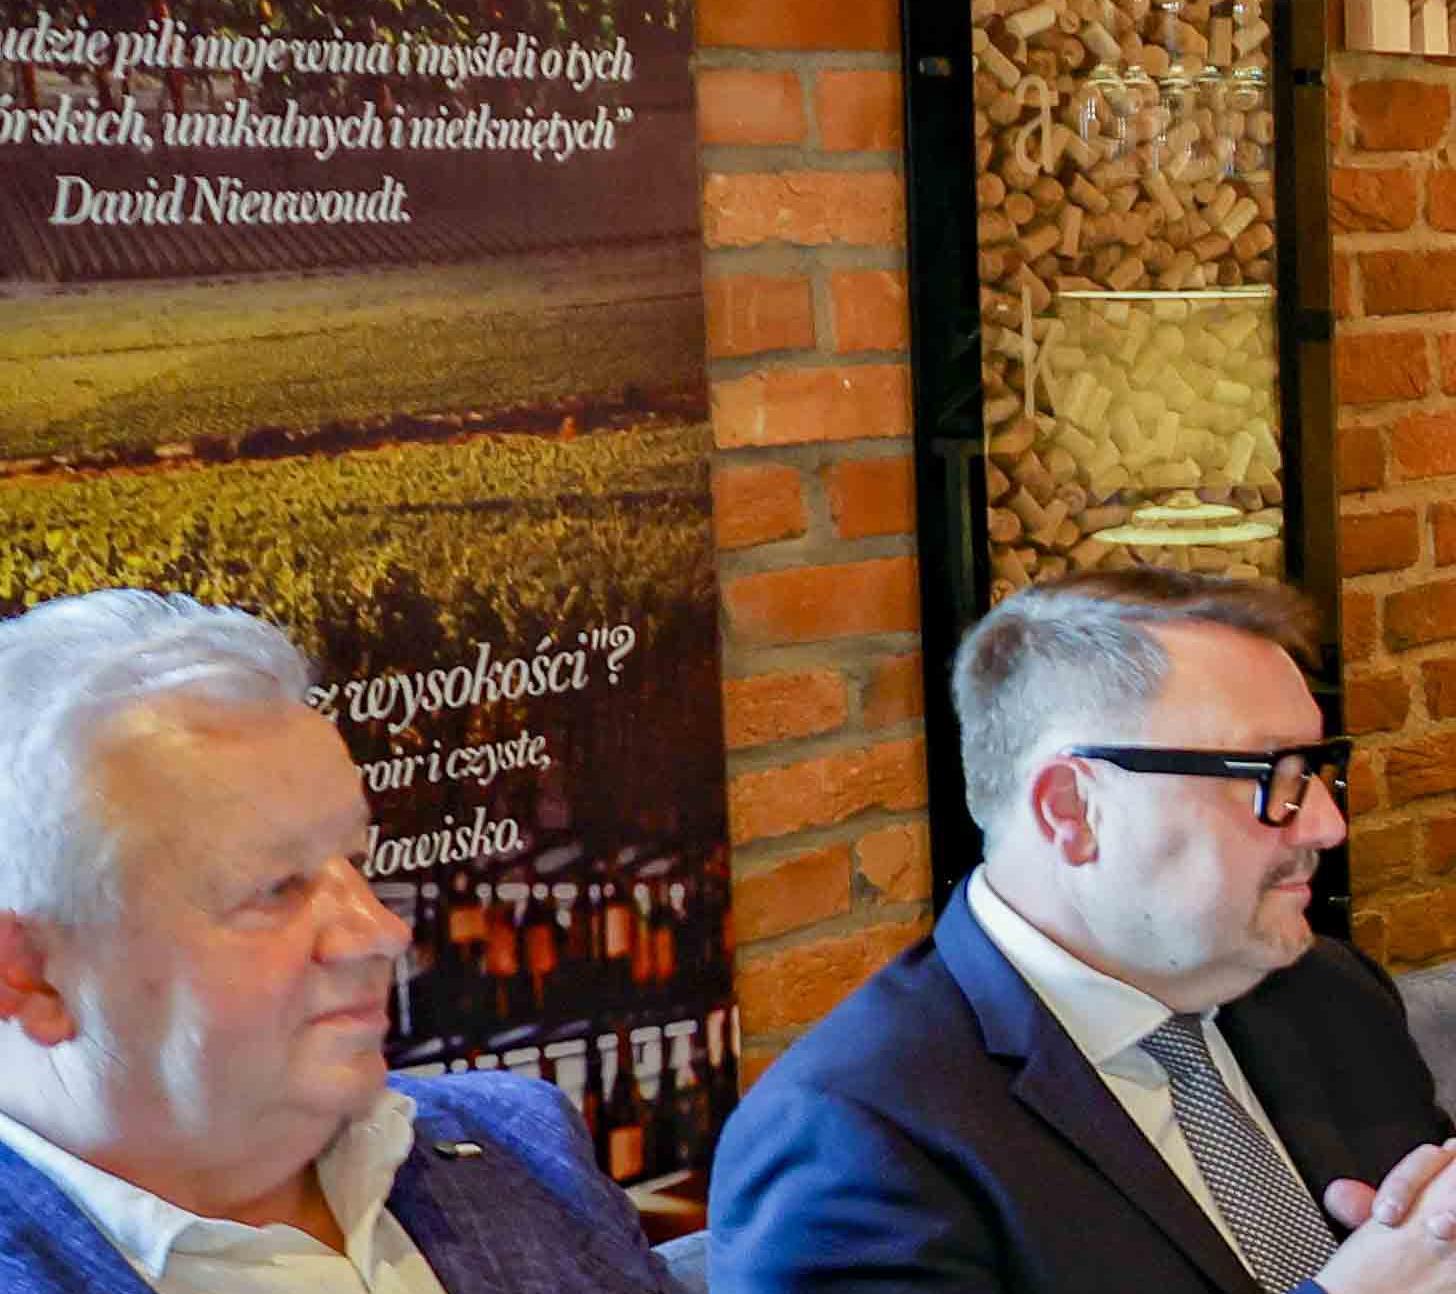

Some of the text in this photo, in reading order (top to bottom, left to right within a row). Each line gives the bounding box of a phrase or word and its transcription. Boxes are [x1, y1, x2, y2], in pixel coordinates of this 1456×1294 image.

[112, 17, 187, 80] pili
[189, 23, 290, 83] moje
[287, 28, 392, 76] wina
[397, 30, 411, 77] i
[415, 31, 536, 90] myśleli
[540, 48, 563, 80] o
[566, 36, 634, 92] tych
[161, 97, 384, 162] unikalnych
[388, 104, 405, 150] i
[49, 174, 411, 225] David Nieuwoudt.
[426, 739, 443, 783] i
[446, 730, 551, 786] czyste,
